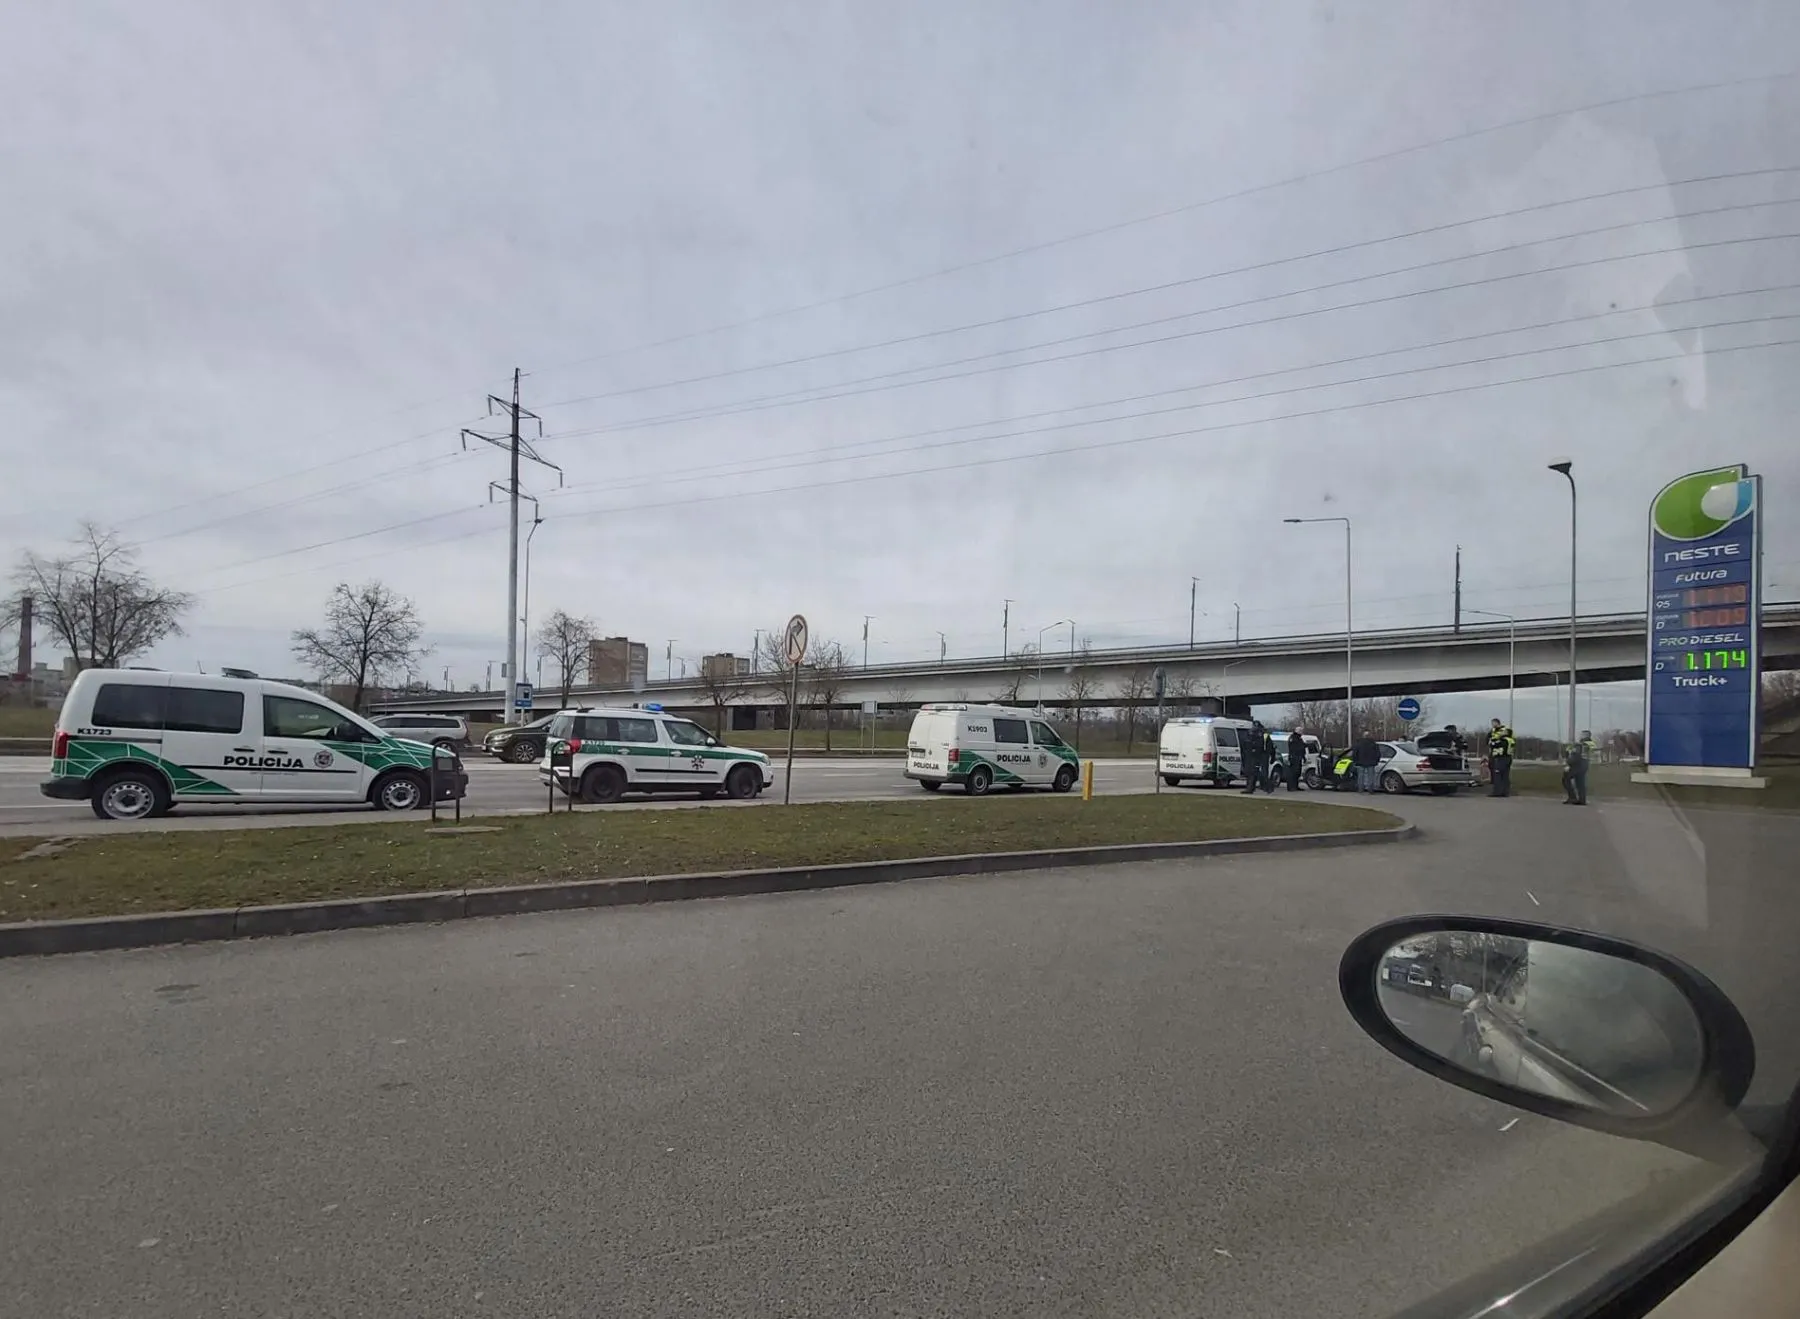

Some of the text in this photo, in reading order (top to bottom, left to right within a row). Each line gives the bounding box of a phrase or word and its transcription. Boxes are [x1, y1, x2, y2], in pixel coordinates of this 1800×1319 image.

[1664, 543, 1740, 563] NESTE
[1675, 569, 1728, 584] Futura
[1656, 600, 1670, 608] 95
[1655, 621, 1665, 630] D
[1655, 650, 1746, 671] D 1.174
[1672, 675, 1728, 687] Truck+
[77, 728, 112, 736] K1723
[223, 755, 304, 768] POLICIJA
[996, 754, 1031, 763] POLICIJA
[913, 761, 940, 770] POLICIJA
